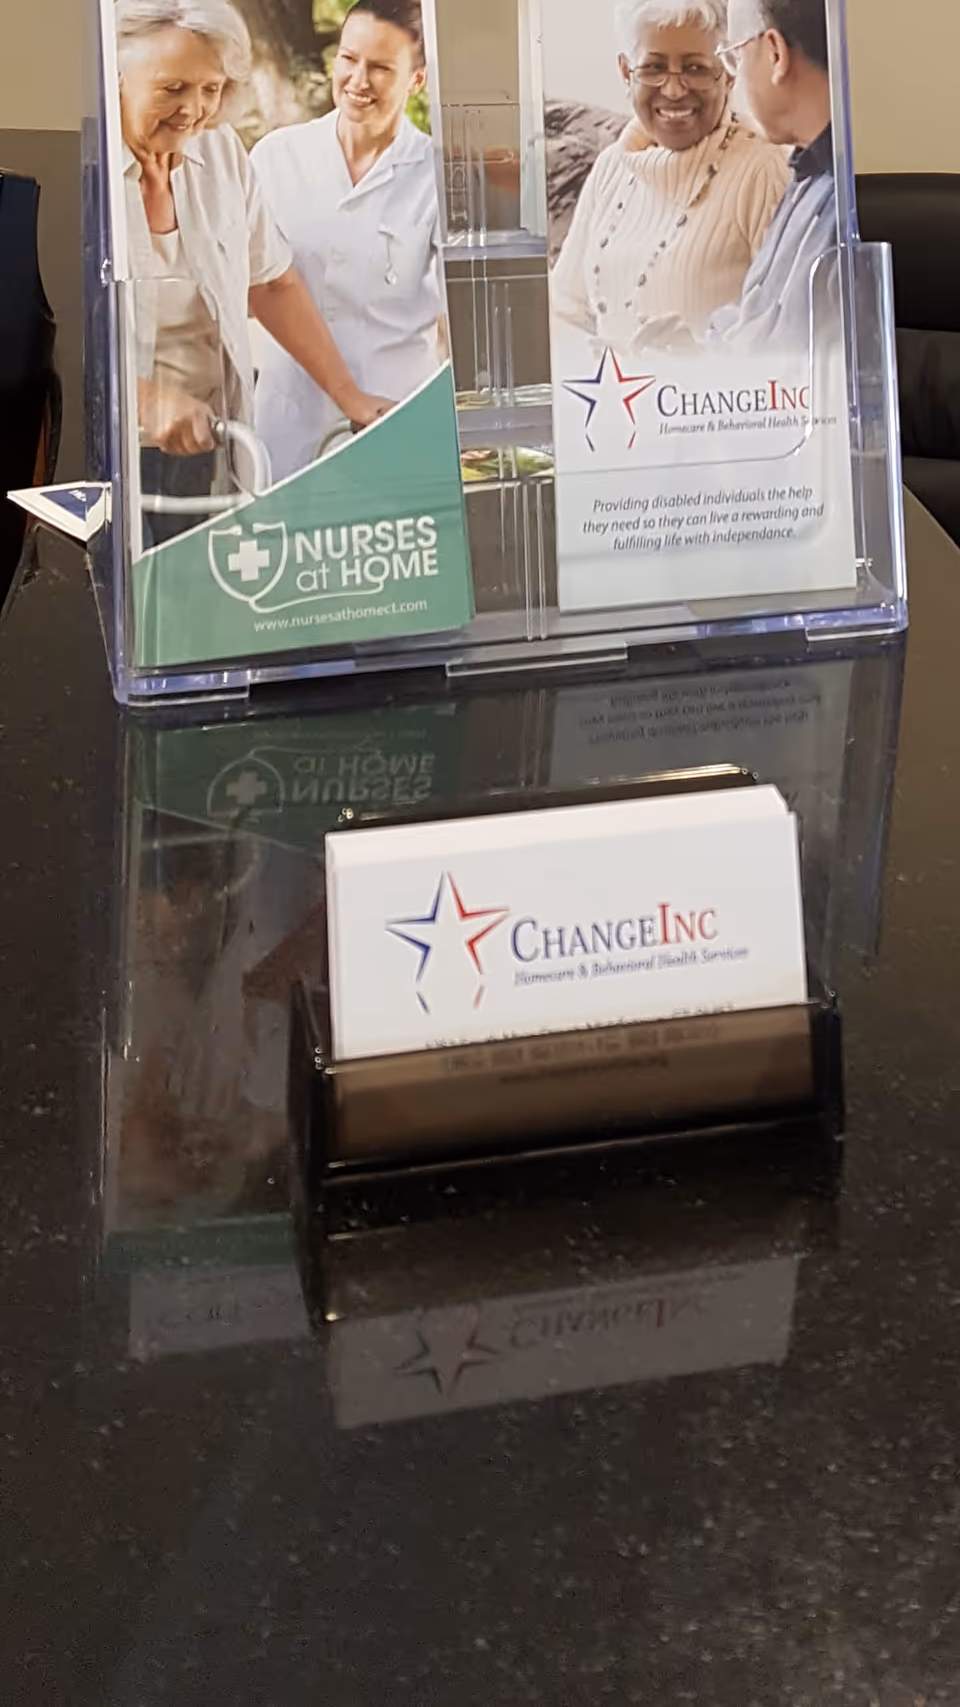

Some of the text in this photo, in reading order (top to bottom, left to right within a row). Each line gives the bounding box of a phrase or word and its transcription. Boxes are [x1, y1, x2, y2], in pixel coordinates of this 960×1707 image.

[659, 420, 704, 434] Homecare
[707, 420, 715, 431] &
[718, 417, 766, 431] Behavioral
[768, 416, 798, 428] Health
[593, 487, 812, 513] Providing disabled individuals the help
[583, 504, 823, 534] they need so they can live a rewarding and
[295, 515, 438, 564] NURSES
[613, 528, 796, 550] fulfilling life with independance.
[296, 548, 439, 593] at HOME
[254, 599, 428, 632] www.nursesathomect.com
